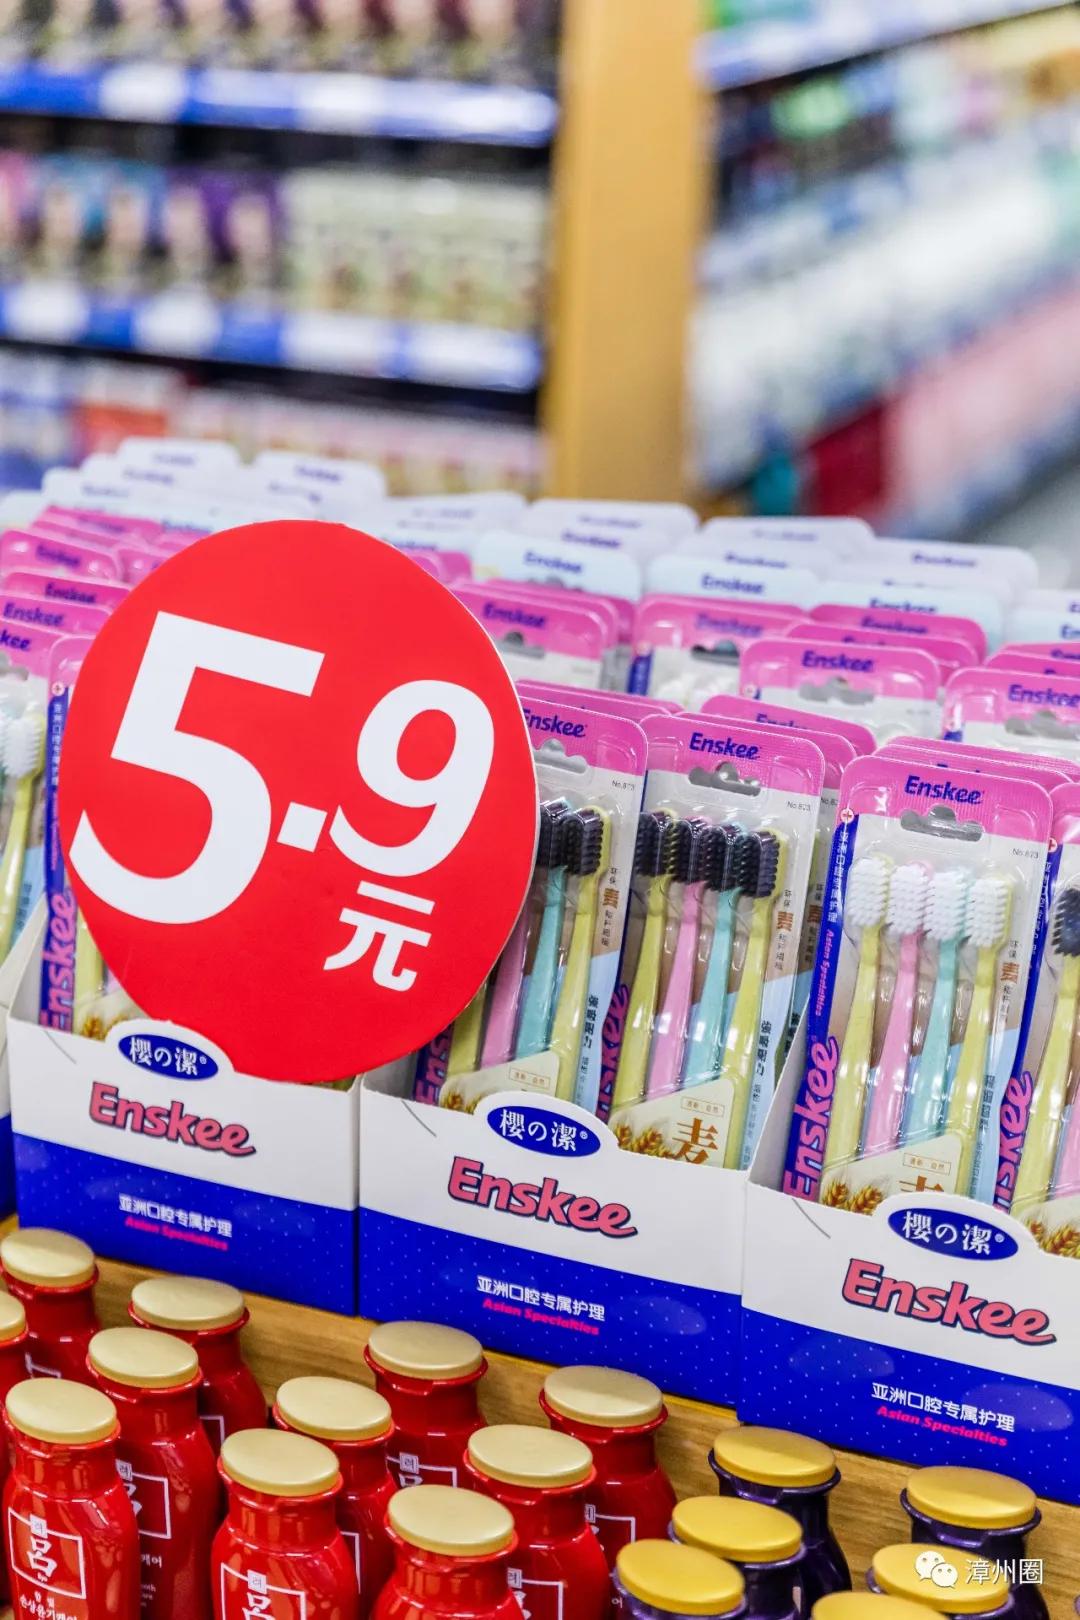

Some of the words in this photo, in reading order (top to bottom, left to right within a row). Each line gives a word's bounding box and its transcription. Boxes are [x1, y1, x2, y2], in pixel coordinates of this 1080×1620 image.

[802, 650, 874, 672] Enskee
[69, 611, 494, 923] 5.9
[689, 732, 760, 759] Enskee
[904, 775, 983, 805] Enskee
[323, 881, 435, 991] 元
[89, 1081, 257, 1157] Enskee
[782, 1035, 840, 1202] Enskee
[118, 1193, 233, 1238] 亚洲口腔专属护理
[448, 1156, 639, 1239] Enskee
[476, 1274, 605, 1322] 亚洲口腔专属护理
[483, 1298, 521, 1317] Asian
[524, 1308, 600, 1335] Specialties
[842, 1258, 1057, 1346] Enskee
[871, 1382, 1015, 1432] 亚洲口腔专属护理
[876, 1405, 920, 1425] Asian
[922, 1416, 1007, 1447] Specialties
